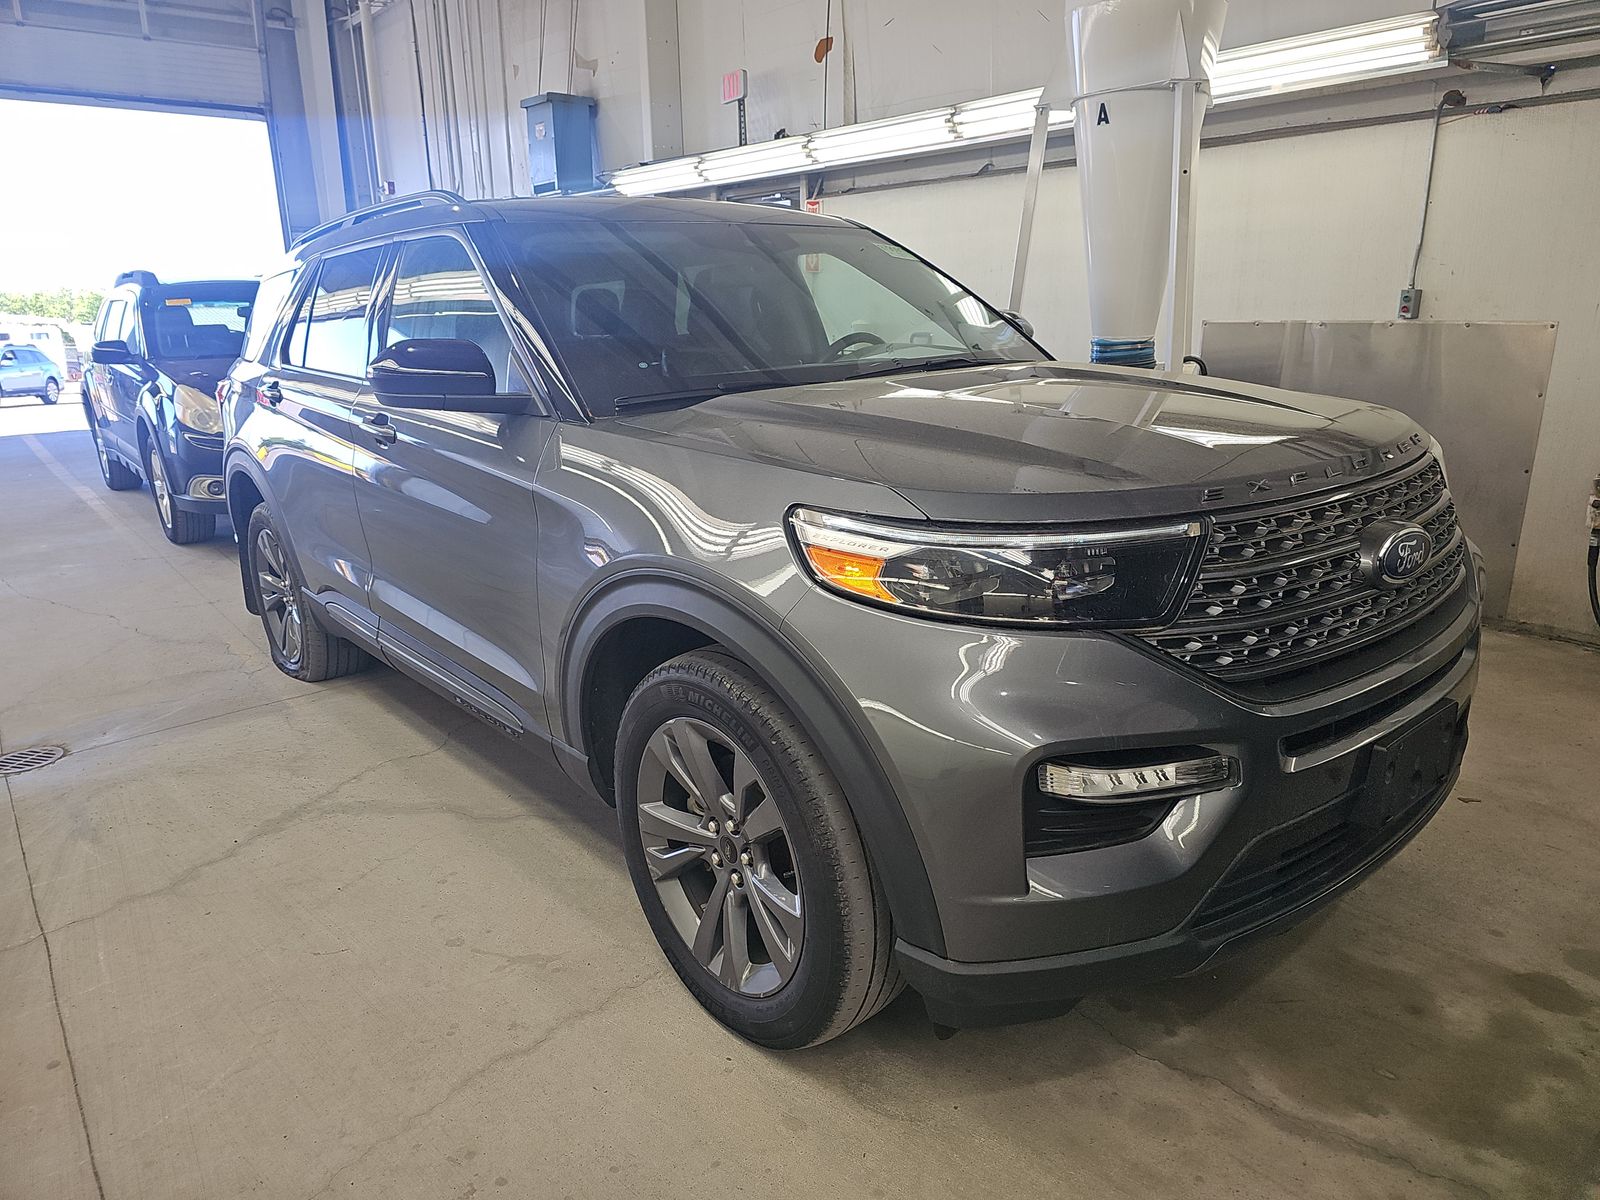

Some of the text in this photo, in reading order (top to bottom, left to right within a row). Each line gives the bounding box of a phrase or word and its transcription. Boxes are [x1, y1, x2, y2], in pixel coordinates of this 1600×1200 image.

[1097, 102, 1110, 126] A
[1201, 432, 1423, 504] EXPLORER
[812, 532, 890, 553] EXPLORER
[1397, 539, 1425, 573] Ford
[687, 689, 758, 748] MICHELIN
